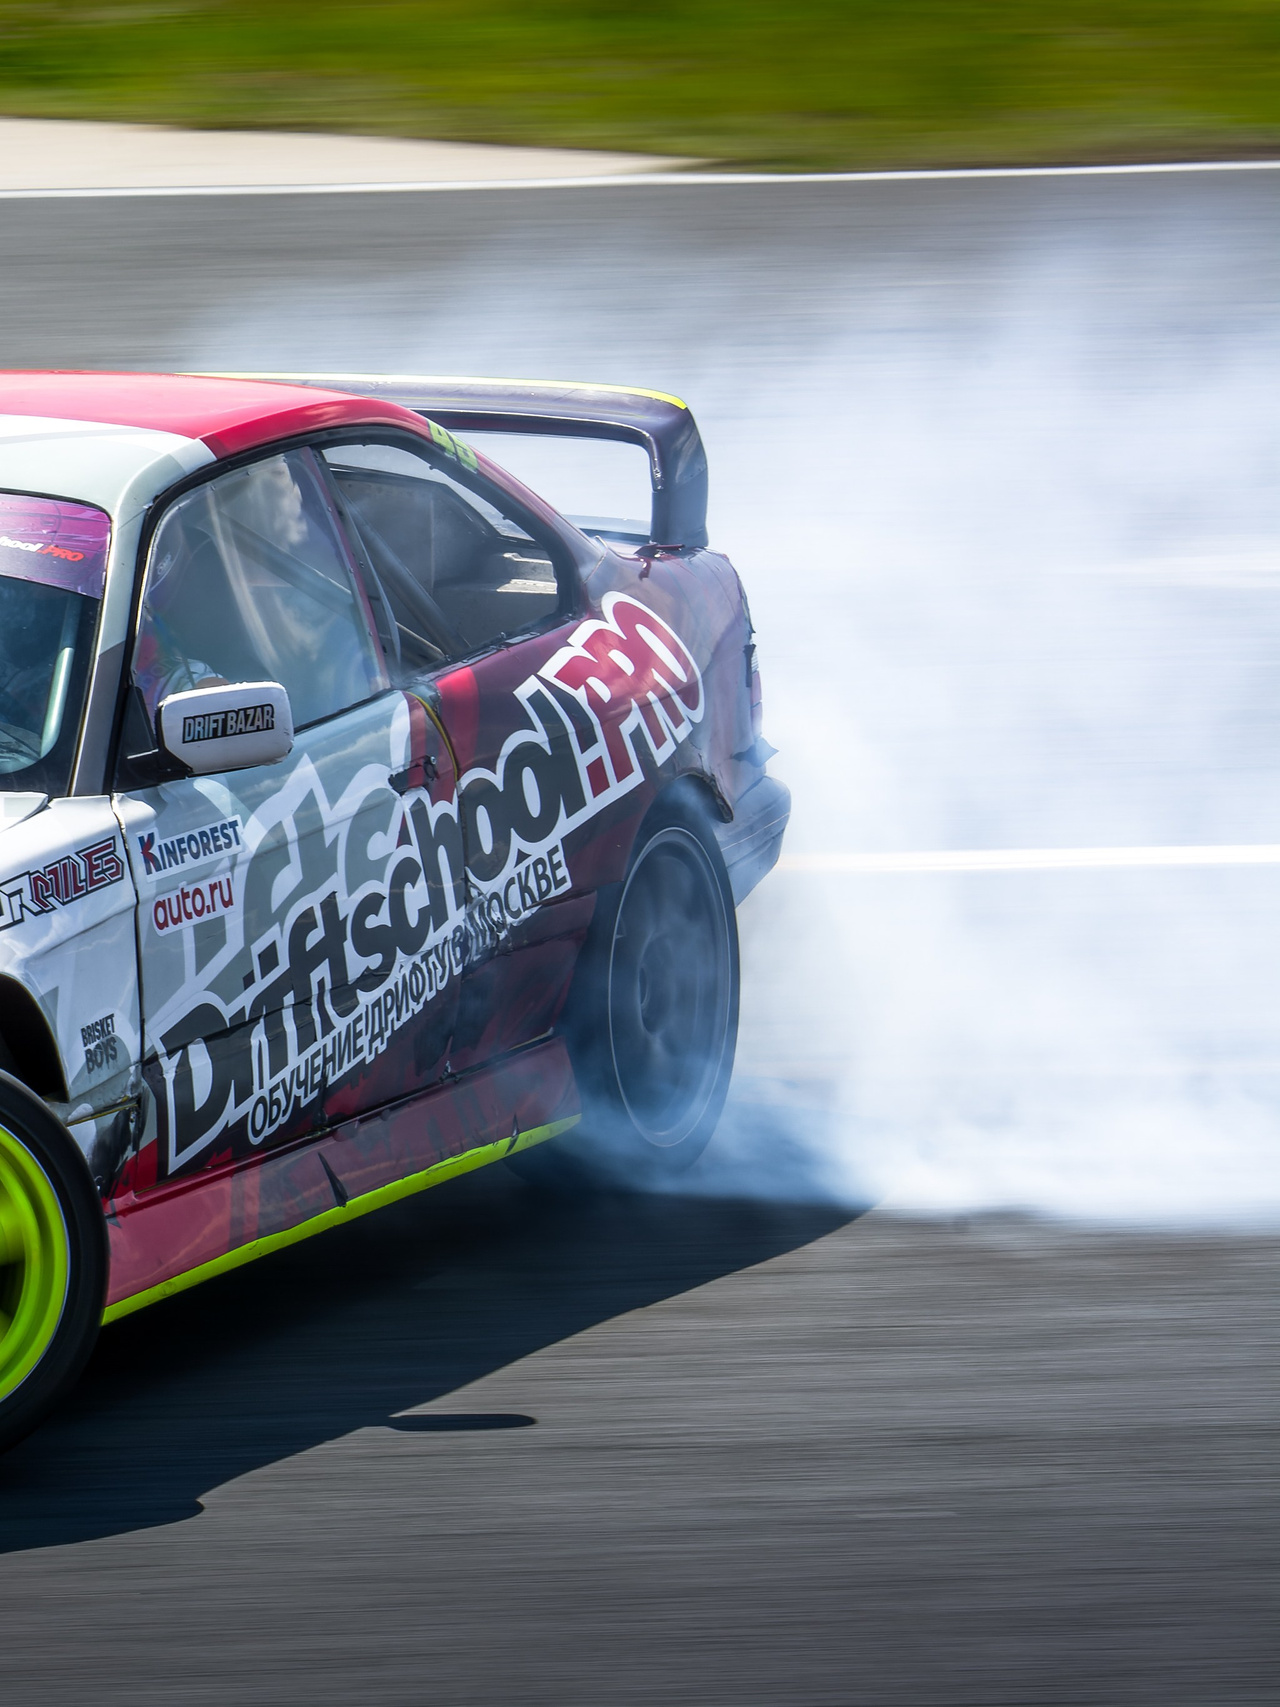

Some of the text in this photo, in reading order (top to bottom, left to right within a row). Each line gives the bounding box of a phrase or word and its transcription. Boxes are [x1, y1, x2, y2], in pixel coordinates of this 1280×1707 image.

[183, 705, 274, 742] DRIFT BAZAR
[138, 819, 241, 875] KINFOREST
[153, 877, 234, 930] auto.ru
[81, 1013, 115, 1048] BRISKET
[249, 1014, 366, 1141] ОБУЧЕНИЕ
[365, 935, 449, 1060] ДРИФТУ
[85, 1036, 118, 1075] BOYS
